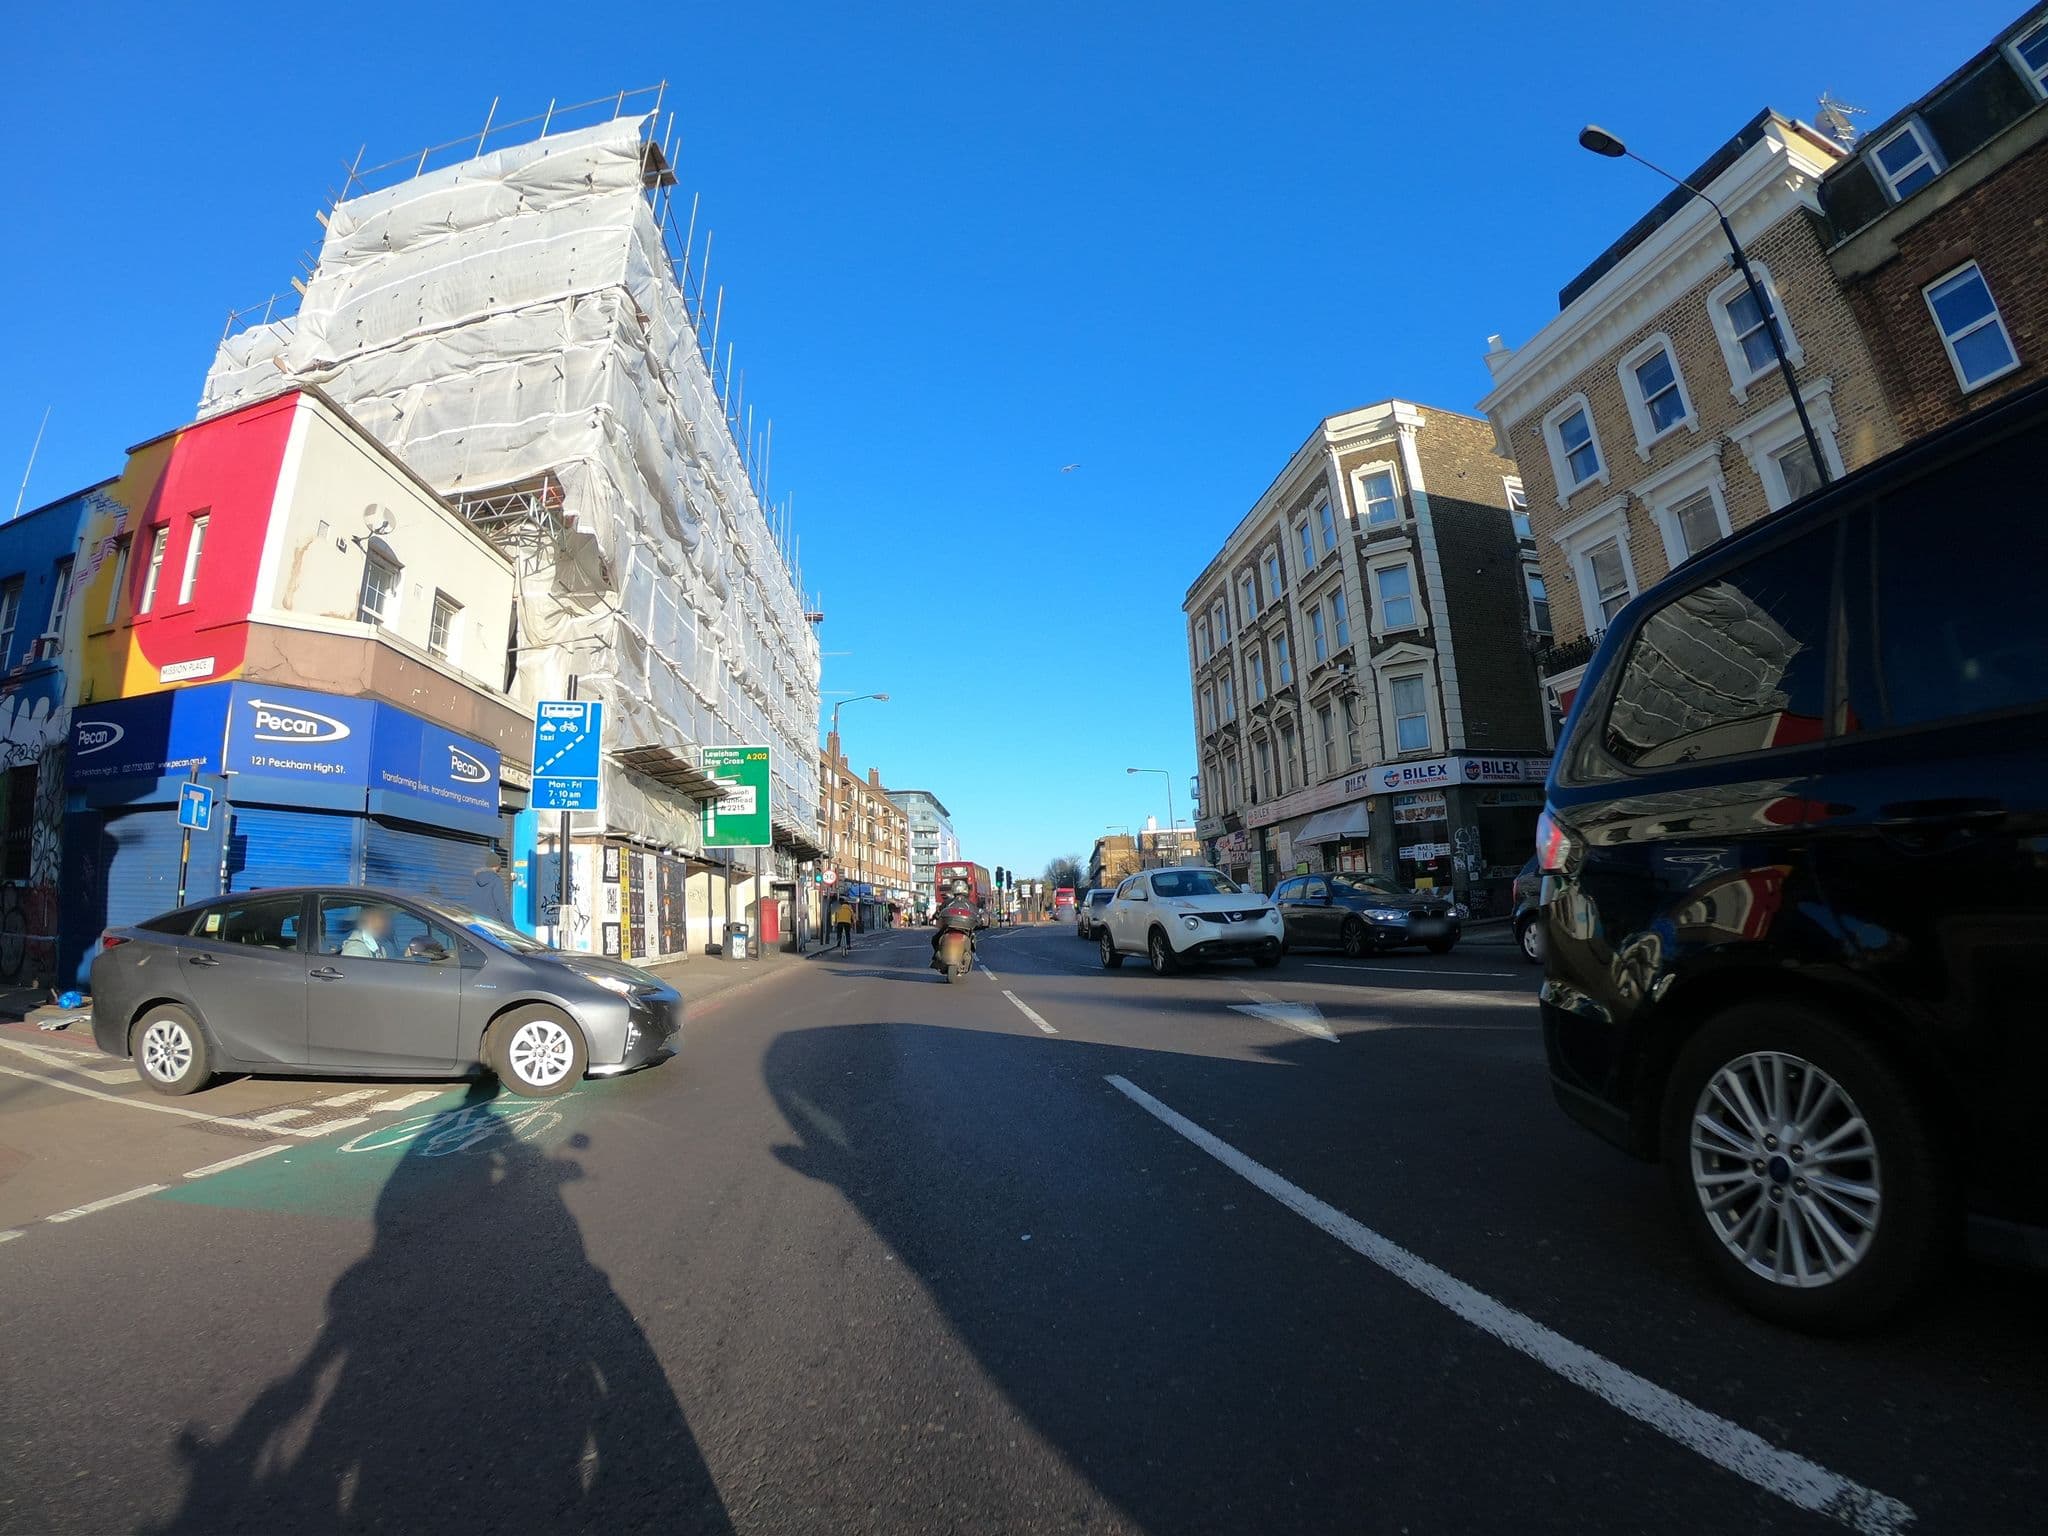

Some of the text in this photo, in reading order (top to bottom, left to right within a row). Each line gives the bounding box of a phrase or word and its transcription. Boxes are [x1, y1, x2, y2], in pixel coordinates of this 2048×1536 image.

[163, 660, 208, 675] MISSION PLACE
[256, 711, 318, 736] Pecan
[78, 730, 108, 746] Pecan
[540, 733, 555, 741] taxi
[704, 750, 768, 761] Lewisham A202
[704, 757, 745, 766] New Cross
[251, 756, 347, 775] 121 Peckham High St.
[451, 755, 478, 777] Pecan
[1403, 763, 1448, 780] BILEX
[1482, 760, 1520, 774] BILEX
[1344, 773, 1368, 794] BILEX
[1403, 775, 1449, 785] INTERNATIONAL
[1482, 772, 1521, 780] INTERNATIONAL
[382, 769, 418, 791] Transforming
[431, 784, 462, 803] transforming
[461, 794, 490, 809] communities
[548, 780, 566, 789] Mon
[571, 780, 583, 789] Fri
[1253, 805, 1272, 820] BILEX
[824, 872, 834, 880] 30
